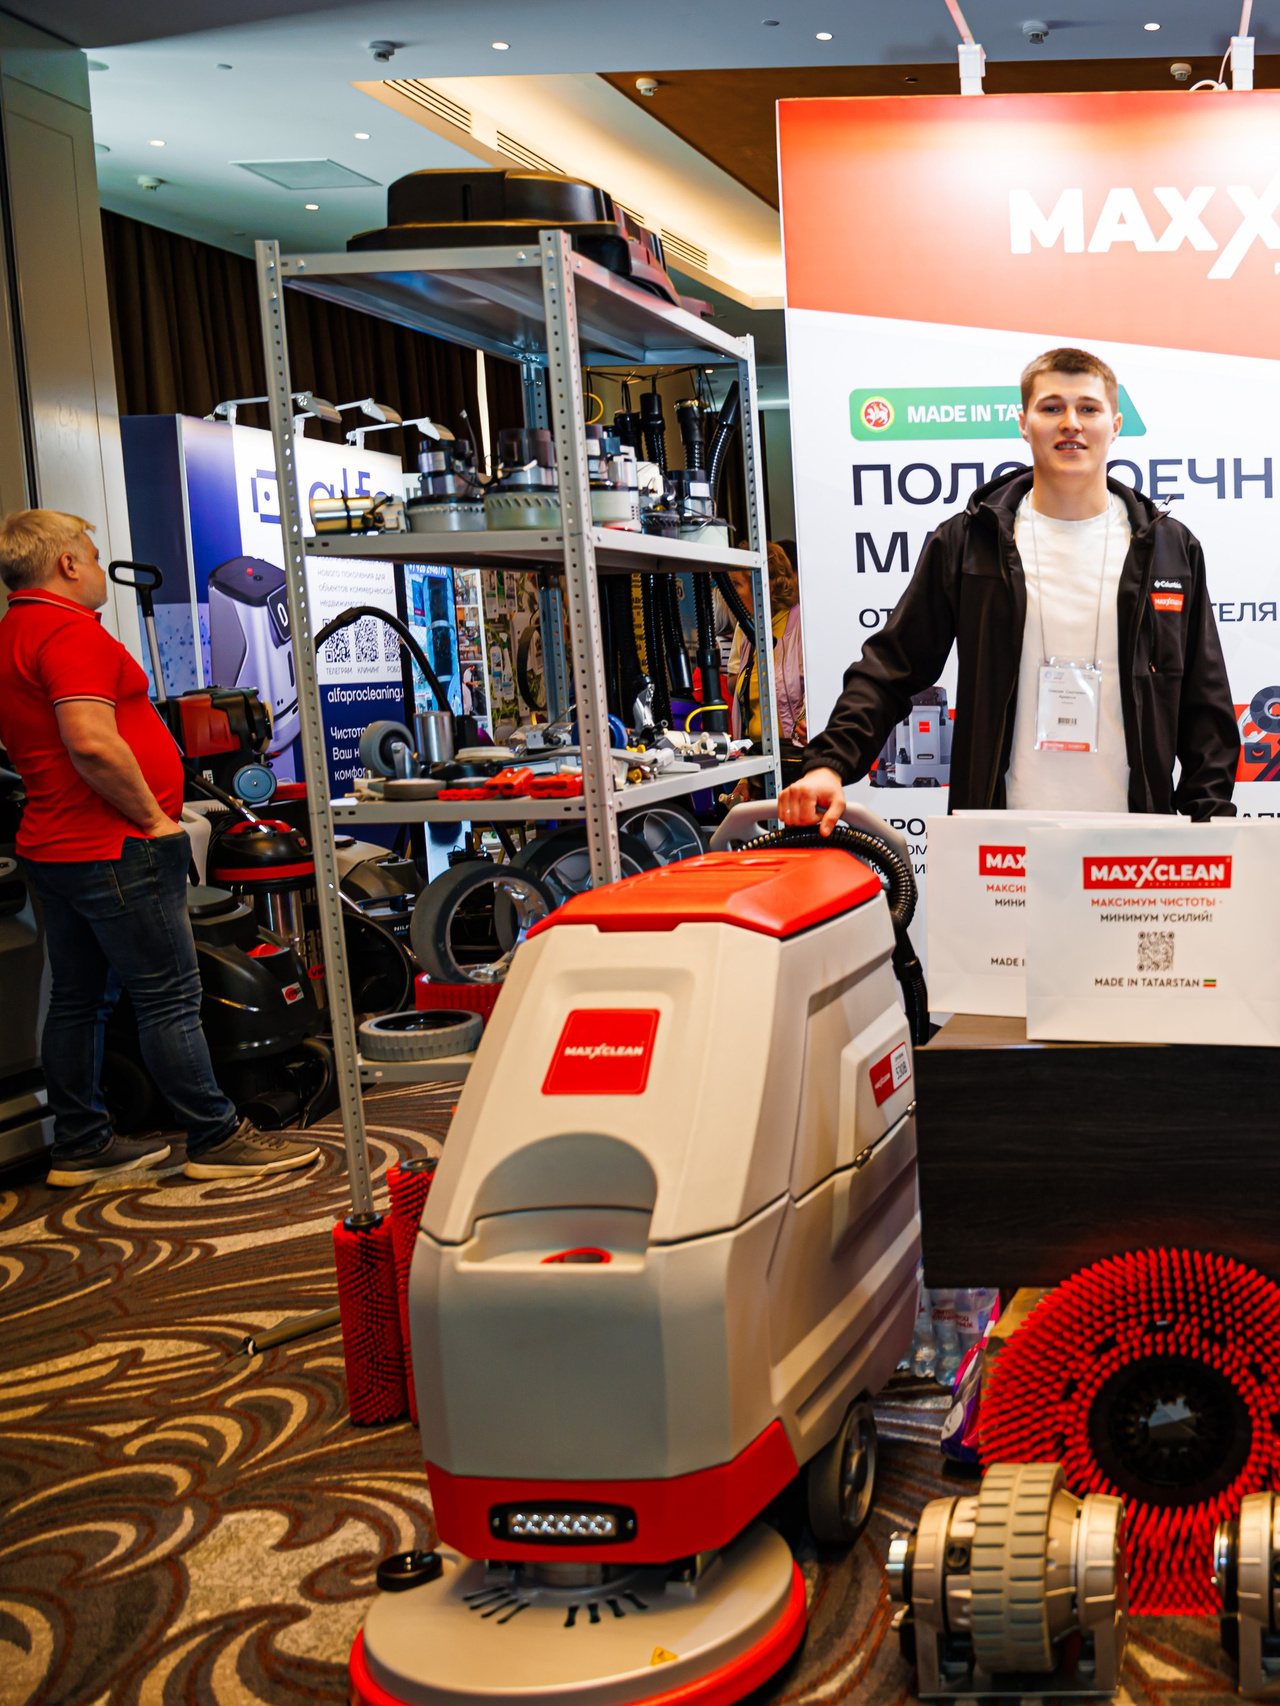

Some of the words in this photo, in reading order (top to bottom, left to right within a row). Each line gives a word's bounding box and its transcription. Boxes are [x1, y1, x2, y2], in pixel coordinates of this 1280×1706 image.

[907, 405, 967, 423] MADE
[970, 405, 991, 422] IN
[332, 746, 353, 761] Ваш
[1090, 857, 1225, 888] MAXXCLEAN
[986, 884, 1026, 894] МАКСИ
[994, 898, 1026, 908] МИНИ
[1091, 897, 1157, 908] МАКСИМУМ
[1160, 897, 1216, 907] ЧИСТОТЫ
[1100, 913, 1159, 923] МИНИМУМ
[1162, 910, 1213, 923] УСИЛИЙ!
[990, 957, 1019, 967] MADE
[1094, 977, 1124, 988] MADE
[1127, 977, 1138, 988] IN
[1141, 977, 1200, 988] TATARSTAN
[563, 1042, 645, 1060] MAXXCLEAN
